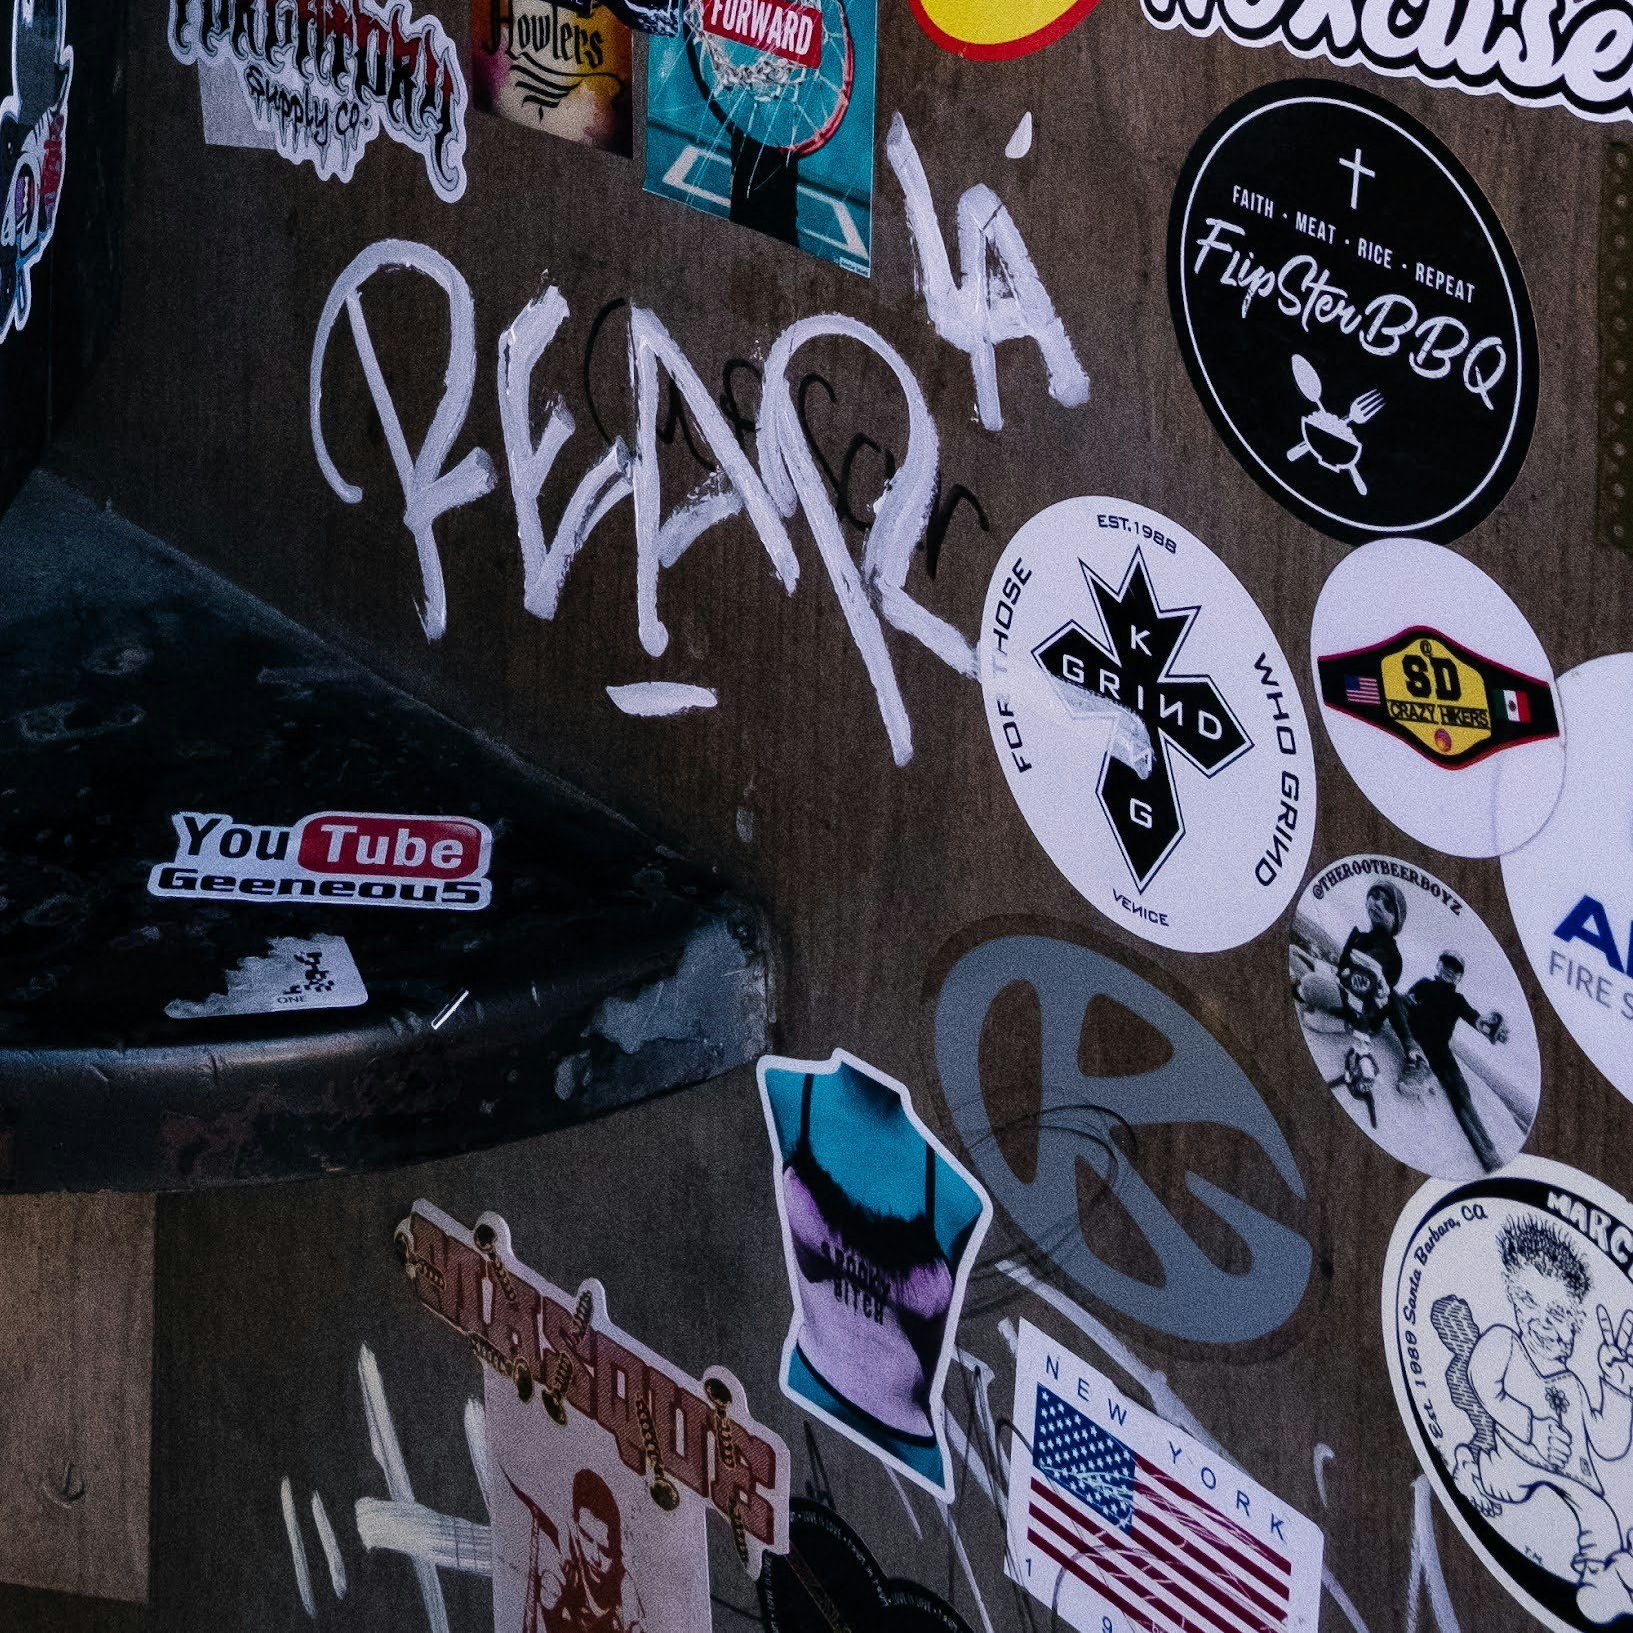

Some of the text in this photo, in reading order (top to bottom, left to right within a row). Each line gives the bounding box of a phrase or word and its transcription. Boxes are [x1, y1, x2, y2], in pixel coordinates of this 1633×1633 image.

[1232, 185, 1477, 304] FAITH MEAT RICE REPEAT
[1252, 653, 1297, 759] WHO
[1405, 653, 1462, 705] SD
[1386, 700, 1490, 730] CRAZY HIKERS
[179, 816, 468, 872] You Tube
[1111, 889, 1170, 927] VENICE
[1548, 949, 1612, 1006] FIRE
[819, 1238, 893, 1304] SPOOKY
[832, 1273, 887, 1325] BITCH
[1045, 1357, 1288, 1543] NEW YORK
